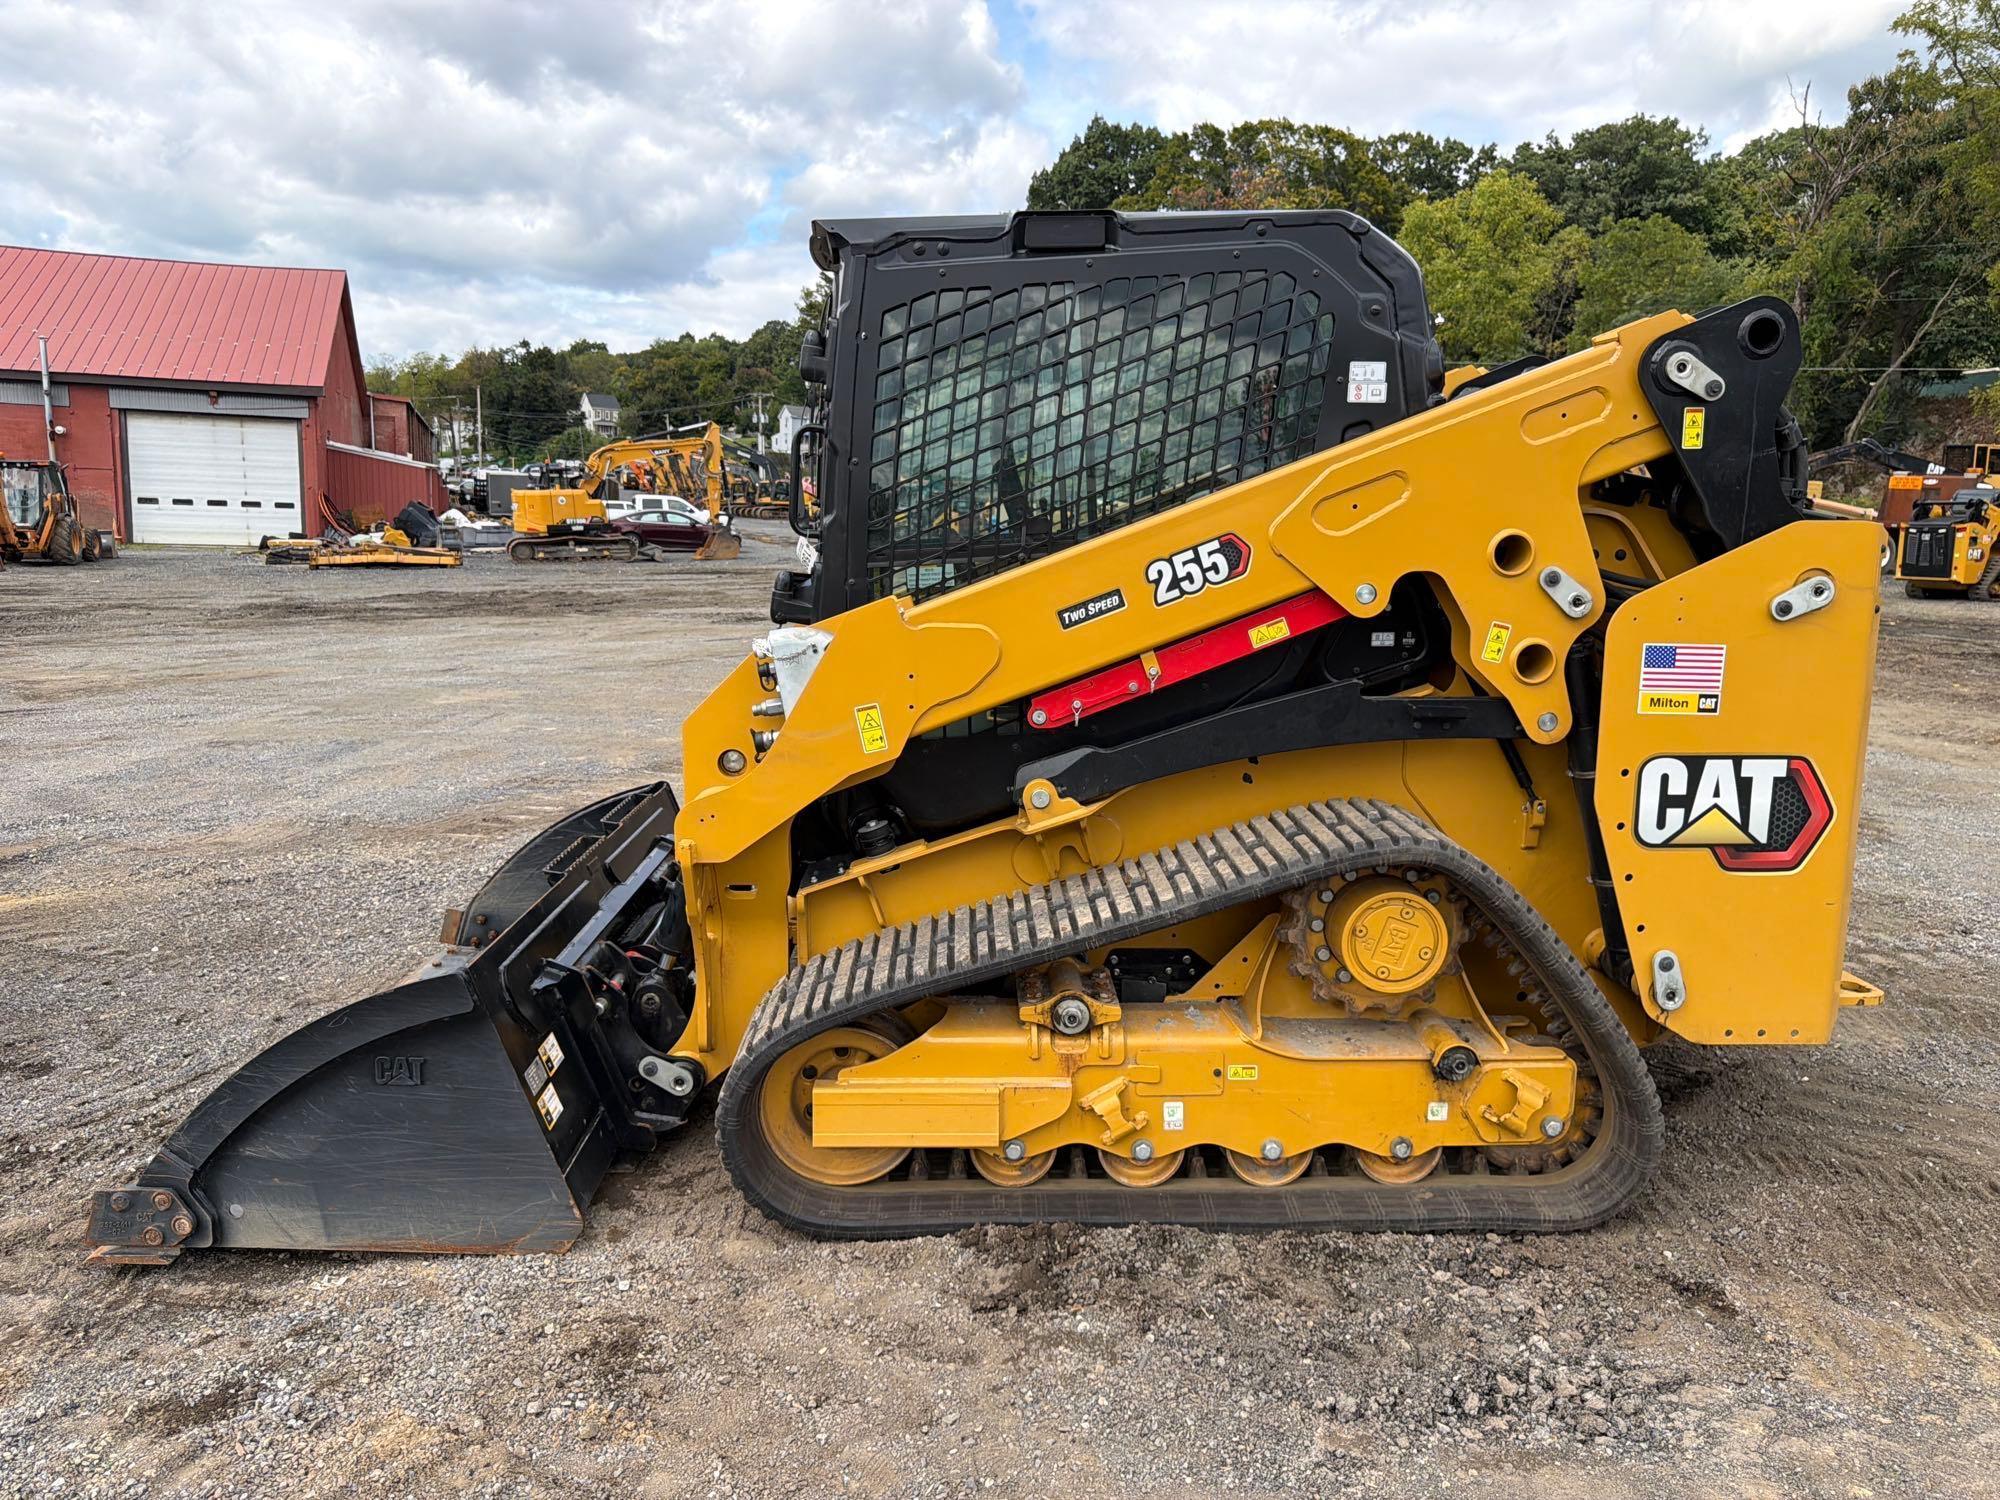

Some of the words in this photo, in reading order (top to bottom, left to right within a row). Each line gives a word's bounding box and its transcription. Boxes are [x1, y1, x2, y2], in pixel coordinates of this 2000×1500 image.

[1926, 463, 1946, 475] CAT
[1967, 549, 1982, 560] CAT
[1149, 539, 1229, 604] 255
[1649, 697, 1689, 708] Milton
[1699, 698, 1717, 709] CAT
[1637, 757, 1788, 844] CAT
[375, 1056, 424, 1086] CAT
[136, 1211, 154, 1222] CAT
